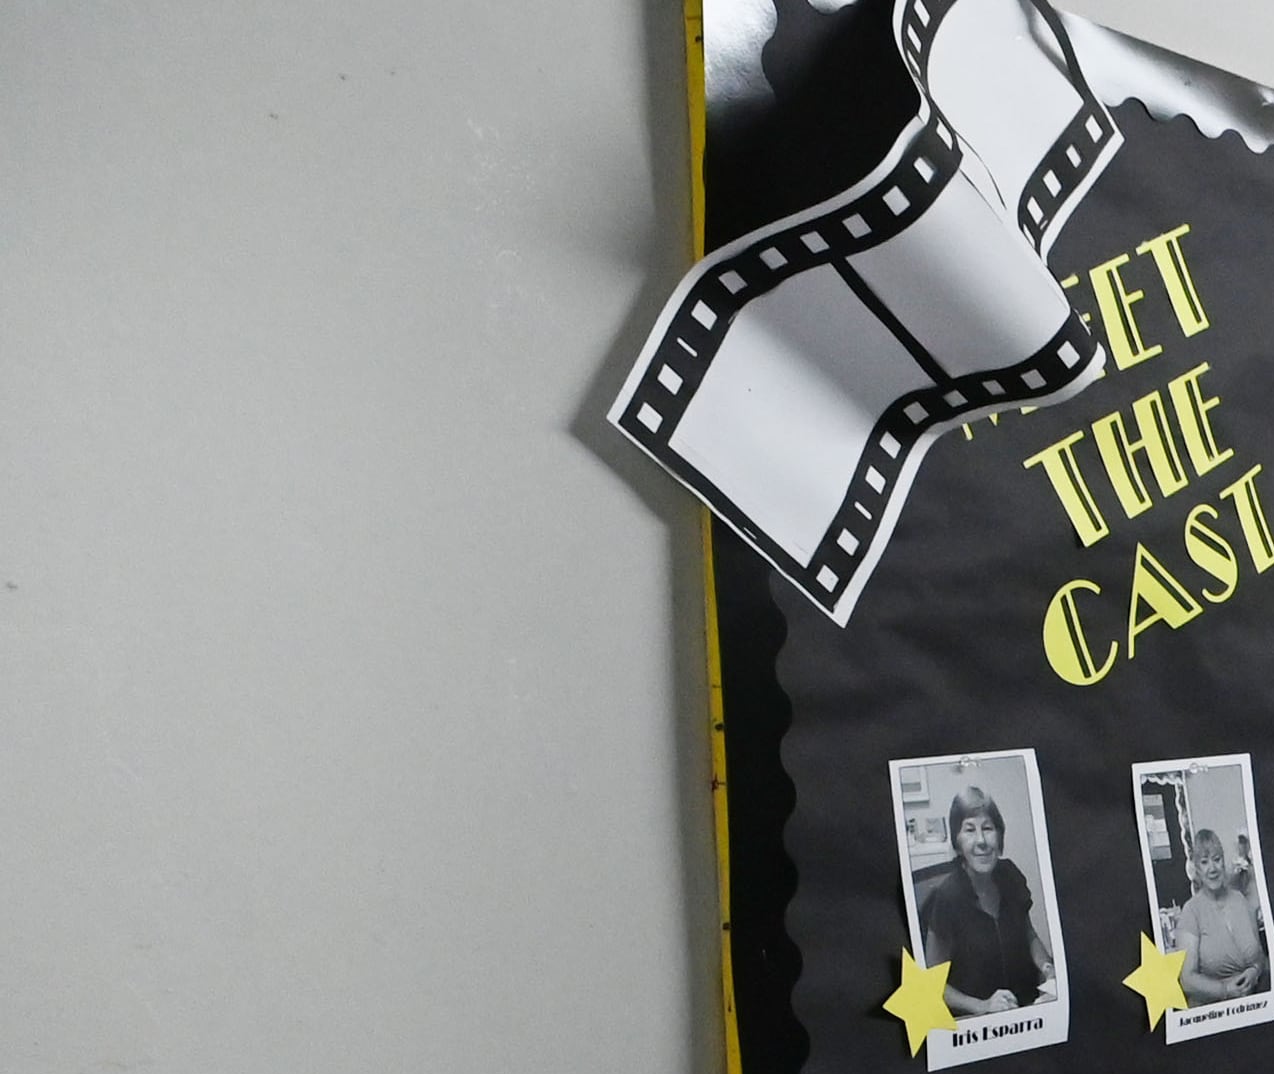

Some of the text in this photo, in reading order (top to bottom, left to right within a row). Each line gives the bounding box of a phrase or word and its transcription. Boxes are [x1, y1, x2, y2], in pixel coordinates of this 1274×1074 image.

[1023, 361, 1235, 548] THE
[951, 1015, 1044, 1048] Iris Esparra
